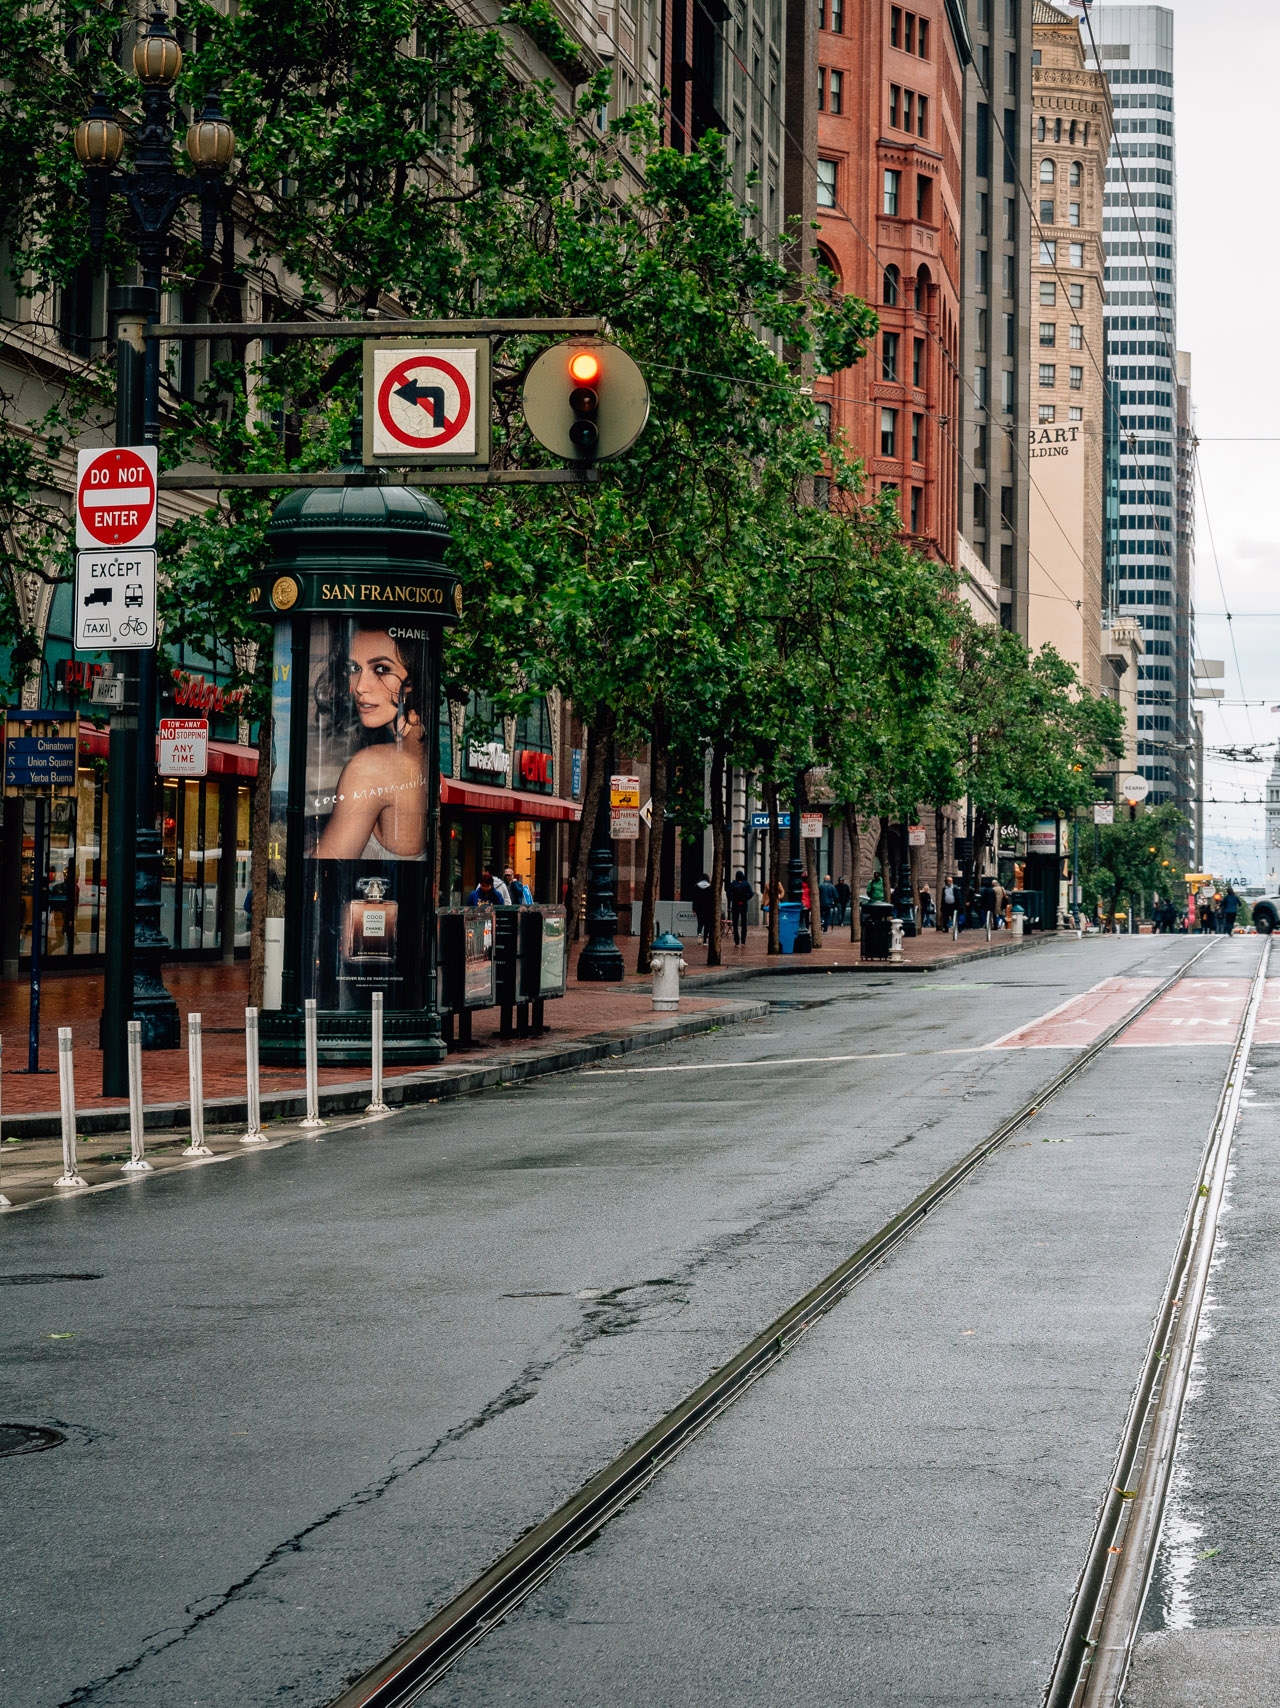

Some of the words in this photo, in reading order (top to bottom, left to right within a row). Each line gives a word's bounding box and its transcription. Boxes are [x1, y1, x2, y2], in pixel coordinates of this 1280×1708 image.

[91, 469, 109, 484] DO
[118, 467, 144, 482] NOT
[94, 510, 138, 527] ENTER
[91, 561, 141, 578] EXCEPT
[322, 584, 355, 600] SAN
[360, 585, 443, 604] FRANCISCO
[86, 623, 108, 633] TAXI
[388, 627, 430, 641] CHANEL
[161, 728, 175, 739] NO
[176, 731, 206, 739] STOPPING
[37, 739, 74, 751] Chinatown
[173, 745, 194, 753] ANY
[27, 756, 47, 767] Union
[49, 757, 73, 769] Square
[171, 755, 195, 763] TIME
[30, 773, 49, 782] Yerba
[50, 773, 73, 782] Buena
[314, 795, 345, 808] COCO
[611, 810, 620, 818] NO
[754, 817, 784, 825] CHAE
